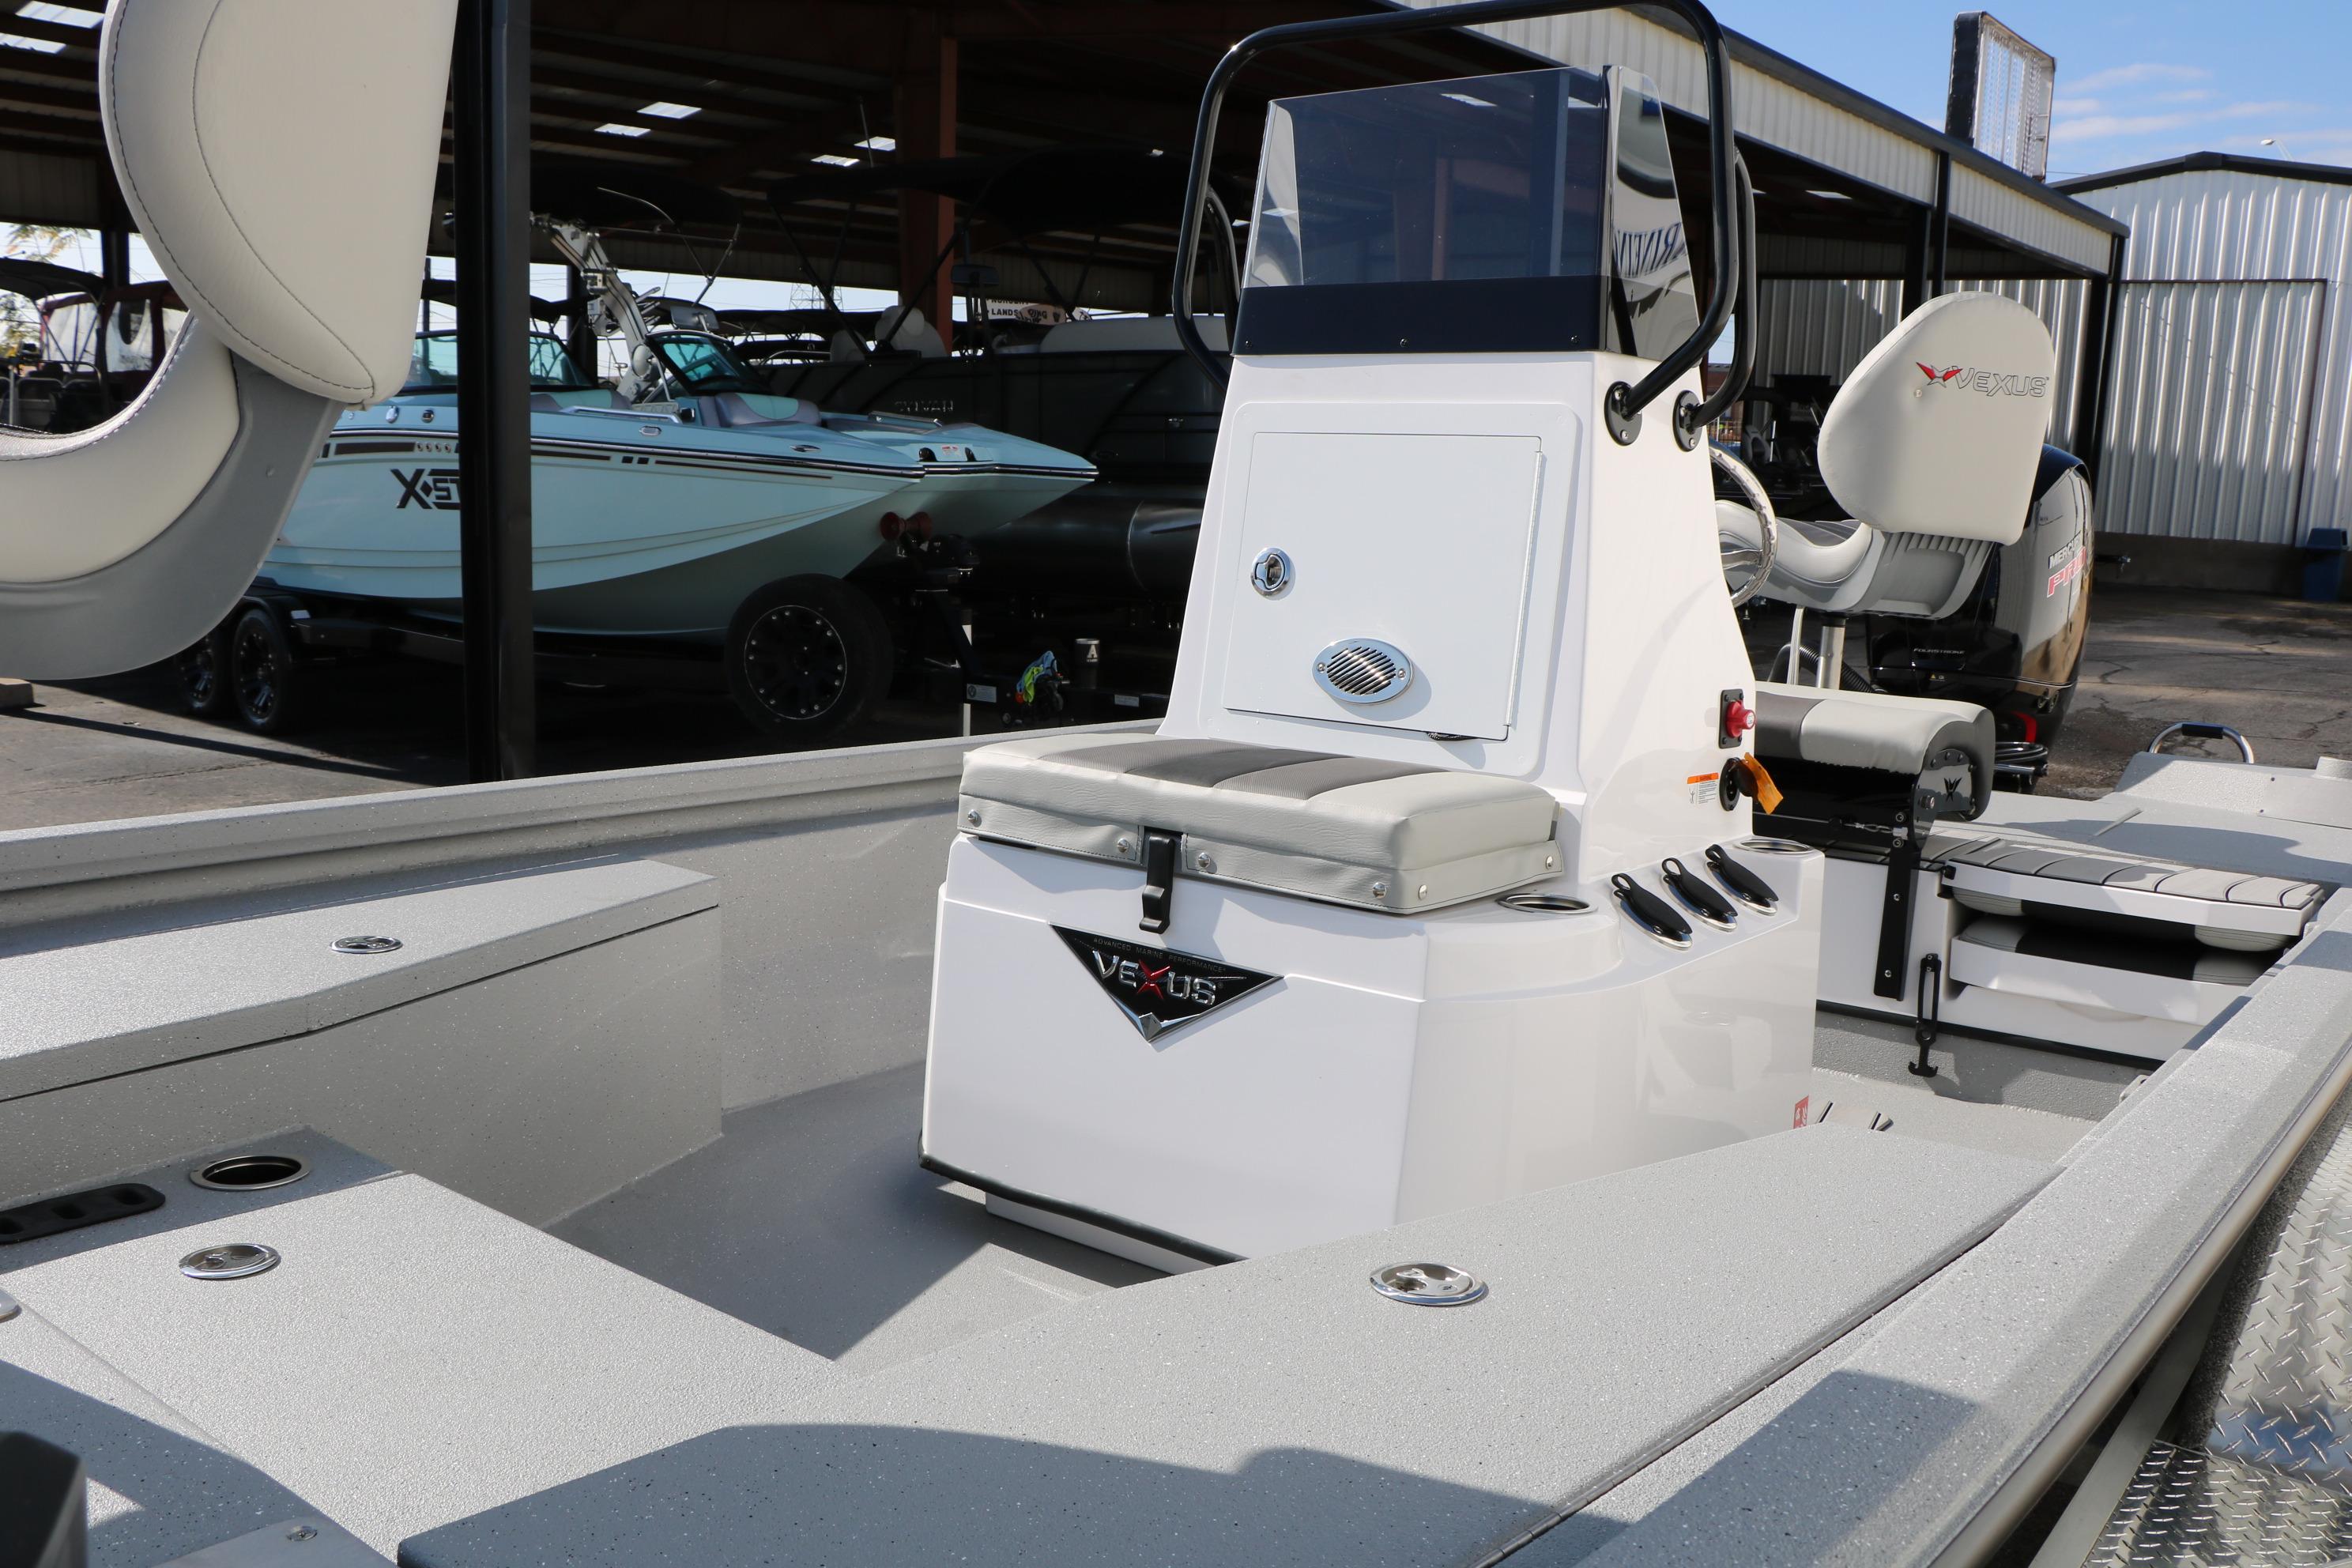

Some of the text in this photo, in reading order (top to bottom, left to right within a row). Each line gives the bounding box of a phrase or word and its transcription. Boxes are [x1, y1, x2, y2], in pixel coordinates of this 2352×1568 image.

[1952, 365, 2046, 398] VEXUS
[1094, 937, 1224, 973] ADVANCED MARINE PERFORMANCE
[1092, 949, 1217, 1006] VEXUS
